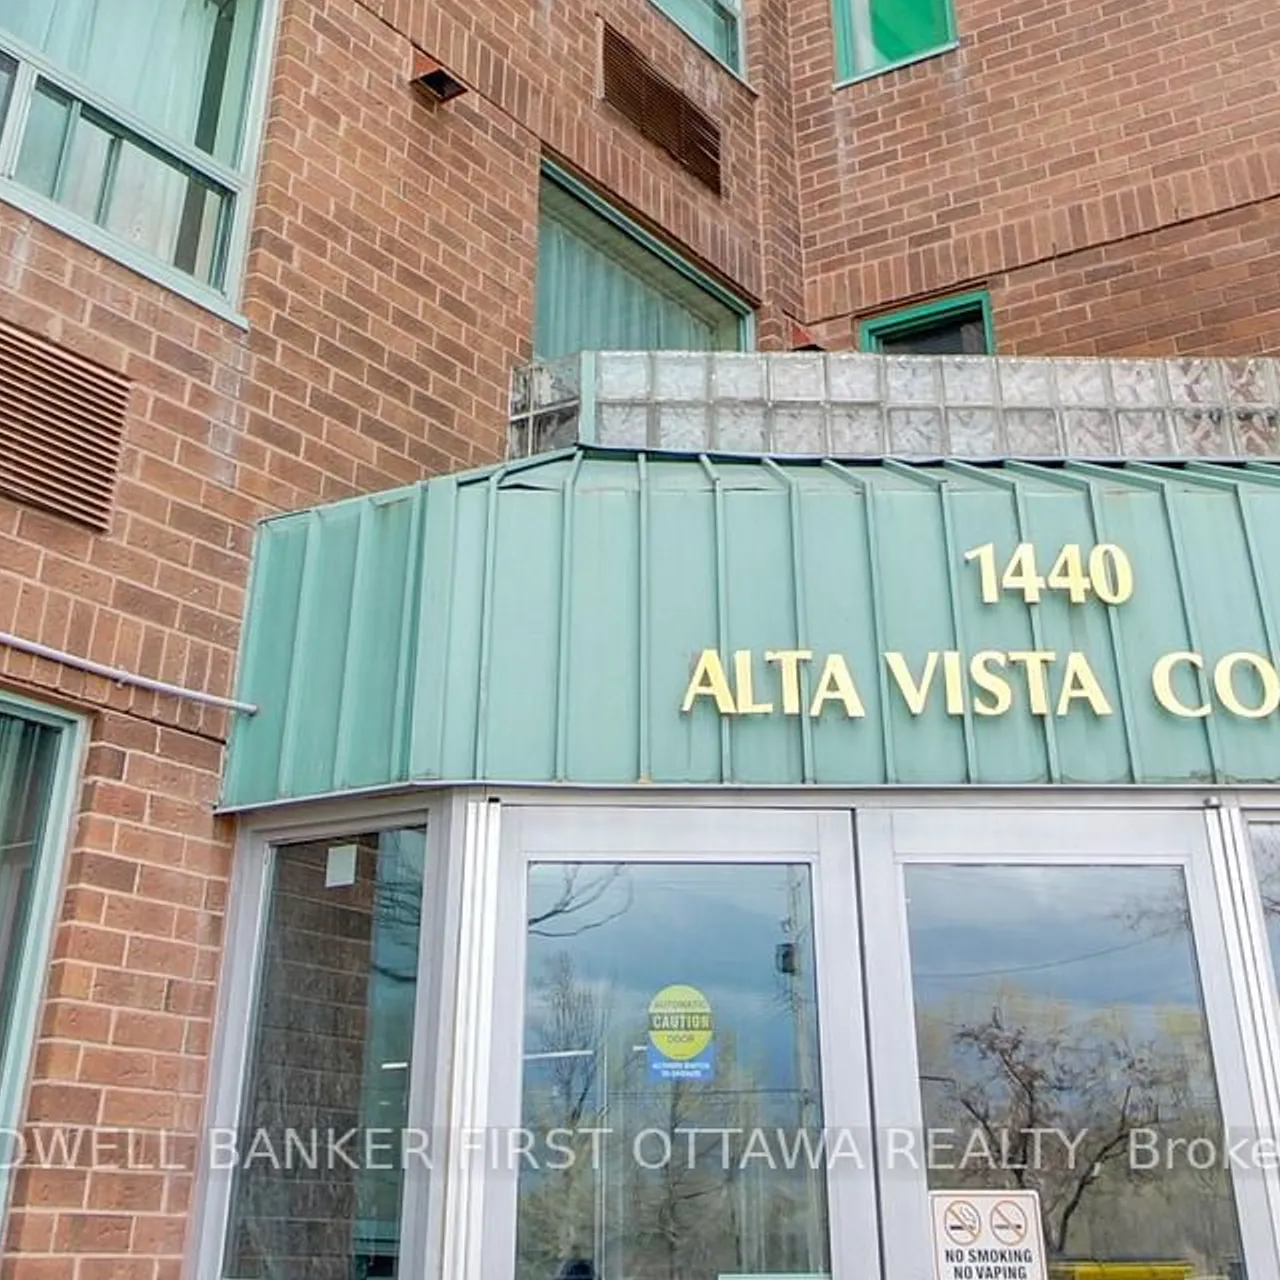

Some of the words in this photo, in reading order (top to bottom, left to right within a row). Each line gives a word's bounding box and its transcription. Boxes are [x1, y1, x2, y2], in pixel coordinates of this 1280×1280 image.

[964, 542, 1134, 604] 1440
[681, 648, 866, 718] ALTA
[883, 651, 1113, 717] VISTA
[652, 1014, 710, 1029] CAUTION
[945, 1248, 964, 1263] NO
[968, 1248, 1033, 1263] SMOKING
[954, 1266, 973, 1279] NO
[976, 1266, 1027, 1279] VAPING
